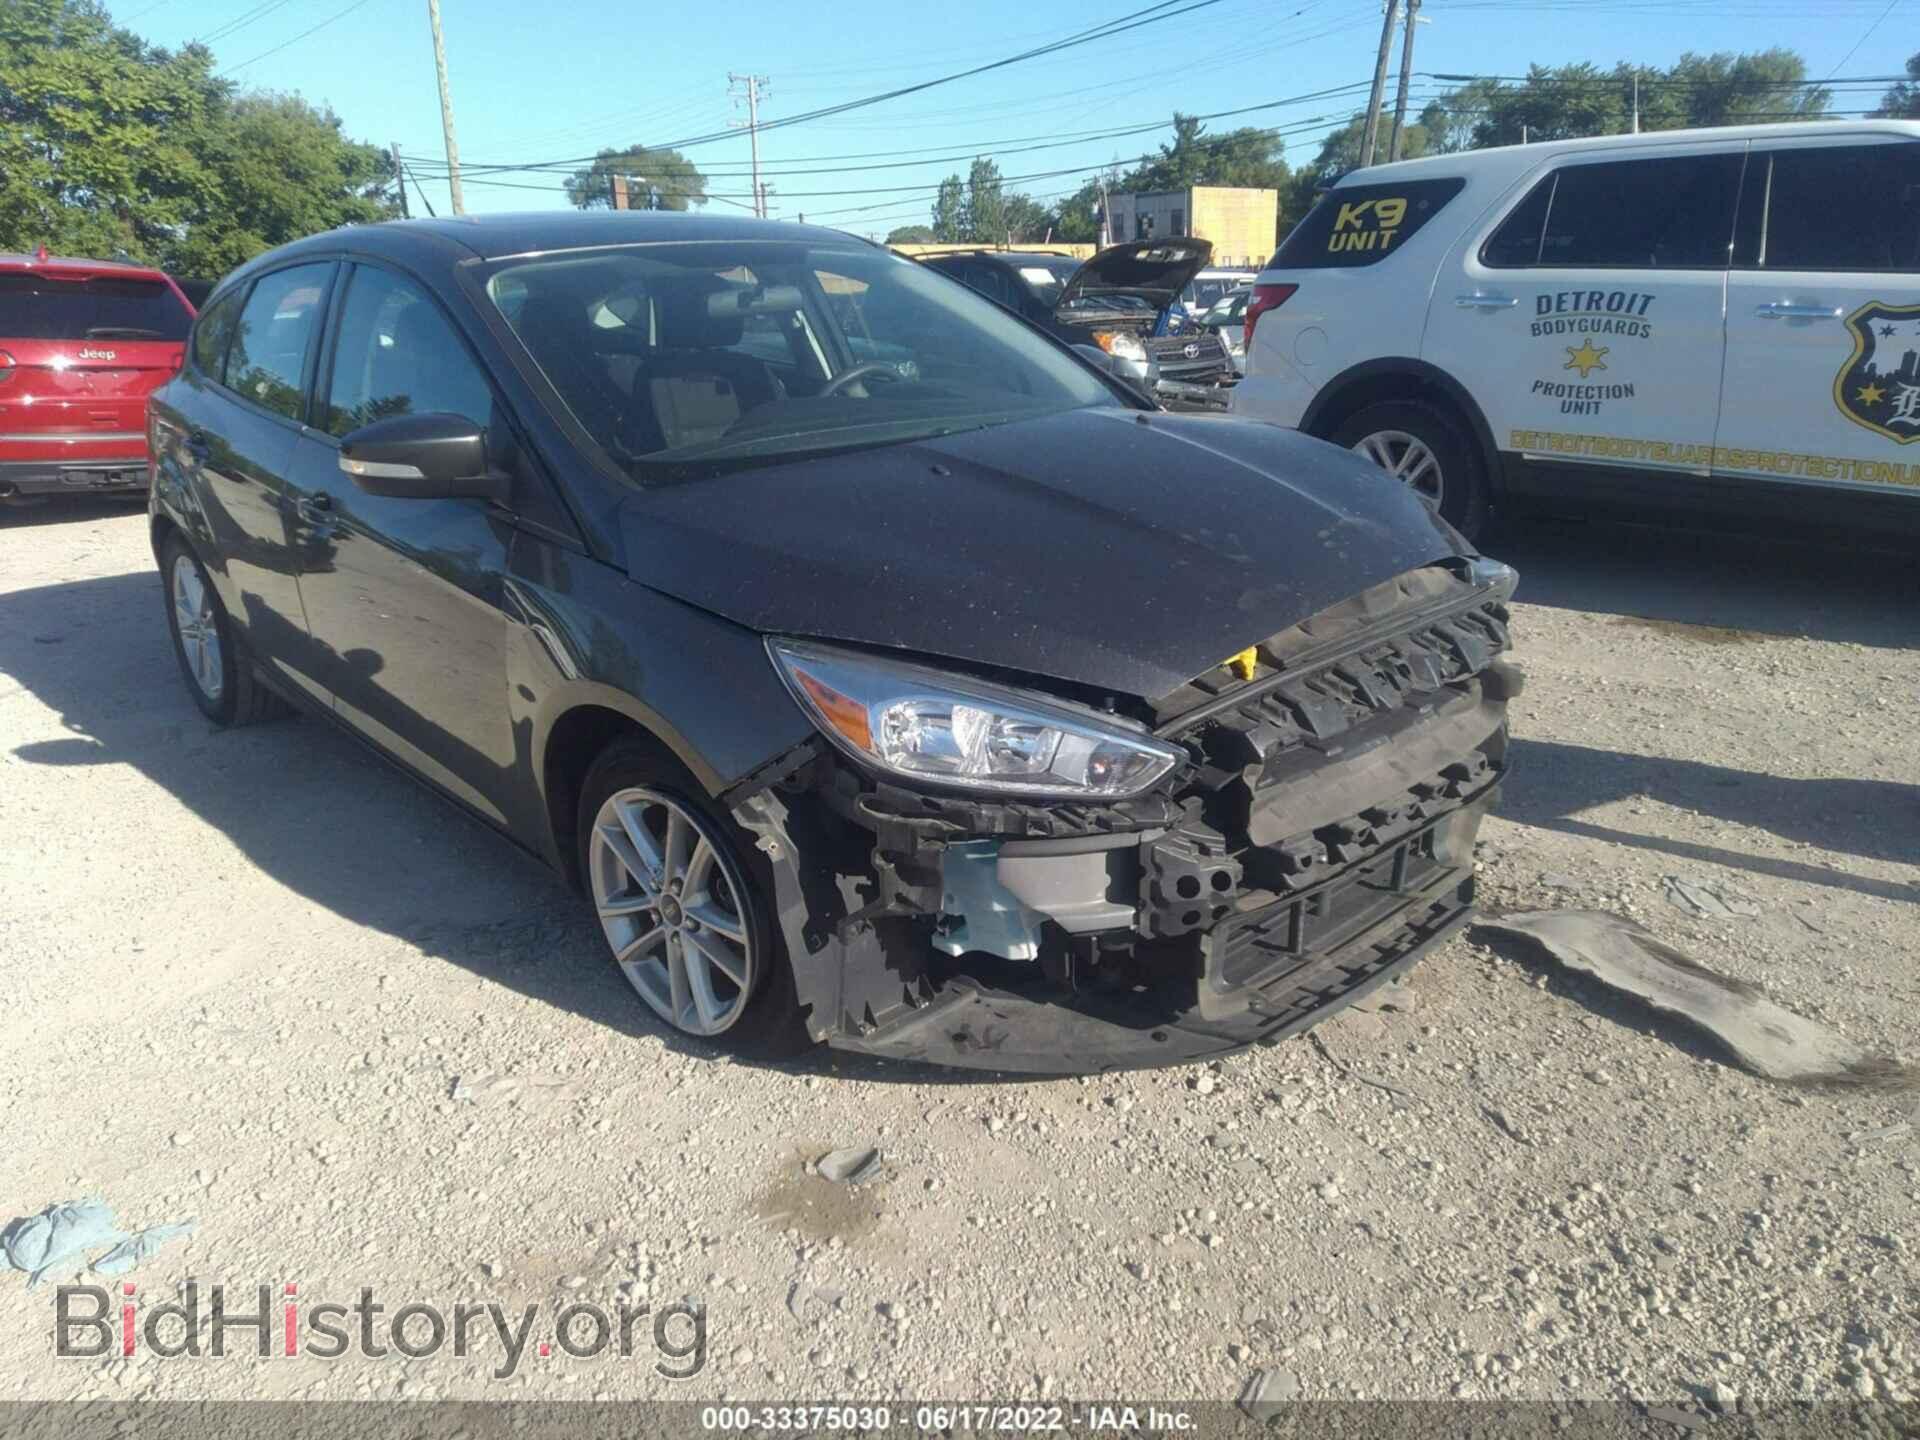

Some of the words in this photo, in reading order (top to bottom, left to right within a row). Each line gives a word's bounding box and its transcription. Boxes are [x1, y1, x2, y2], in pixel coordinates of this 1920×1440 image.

[1334, 198, 1408, 231] K9
[1328, 230, 1398, 252] UNIT
[1536, 290, 1656, 316] DETROIT
[1531, 318, 1652, 339] BODYGUARDS
[79, 348, 116, 361] Jeep
[1532, 380, 1635, 400] PROTECTION
[1560, 400, 1602, 415] UNIT
[1510, 430, 1920, 485] DETROITBODYGUARDSPROTECTIONU
